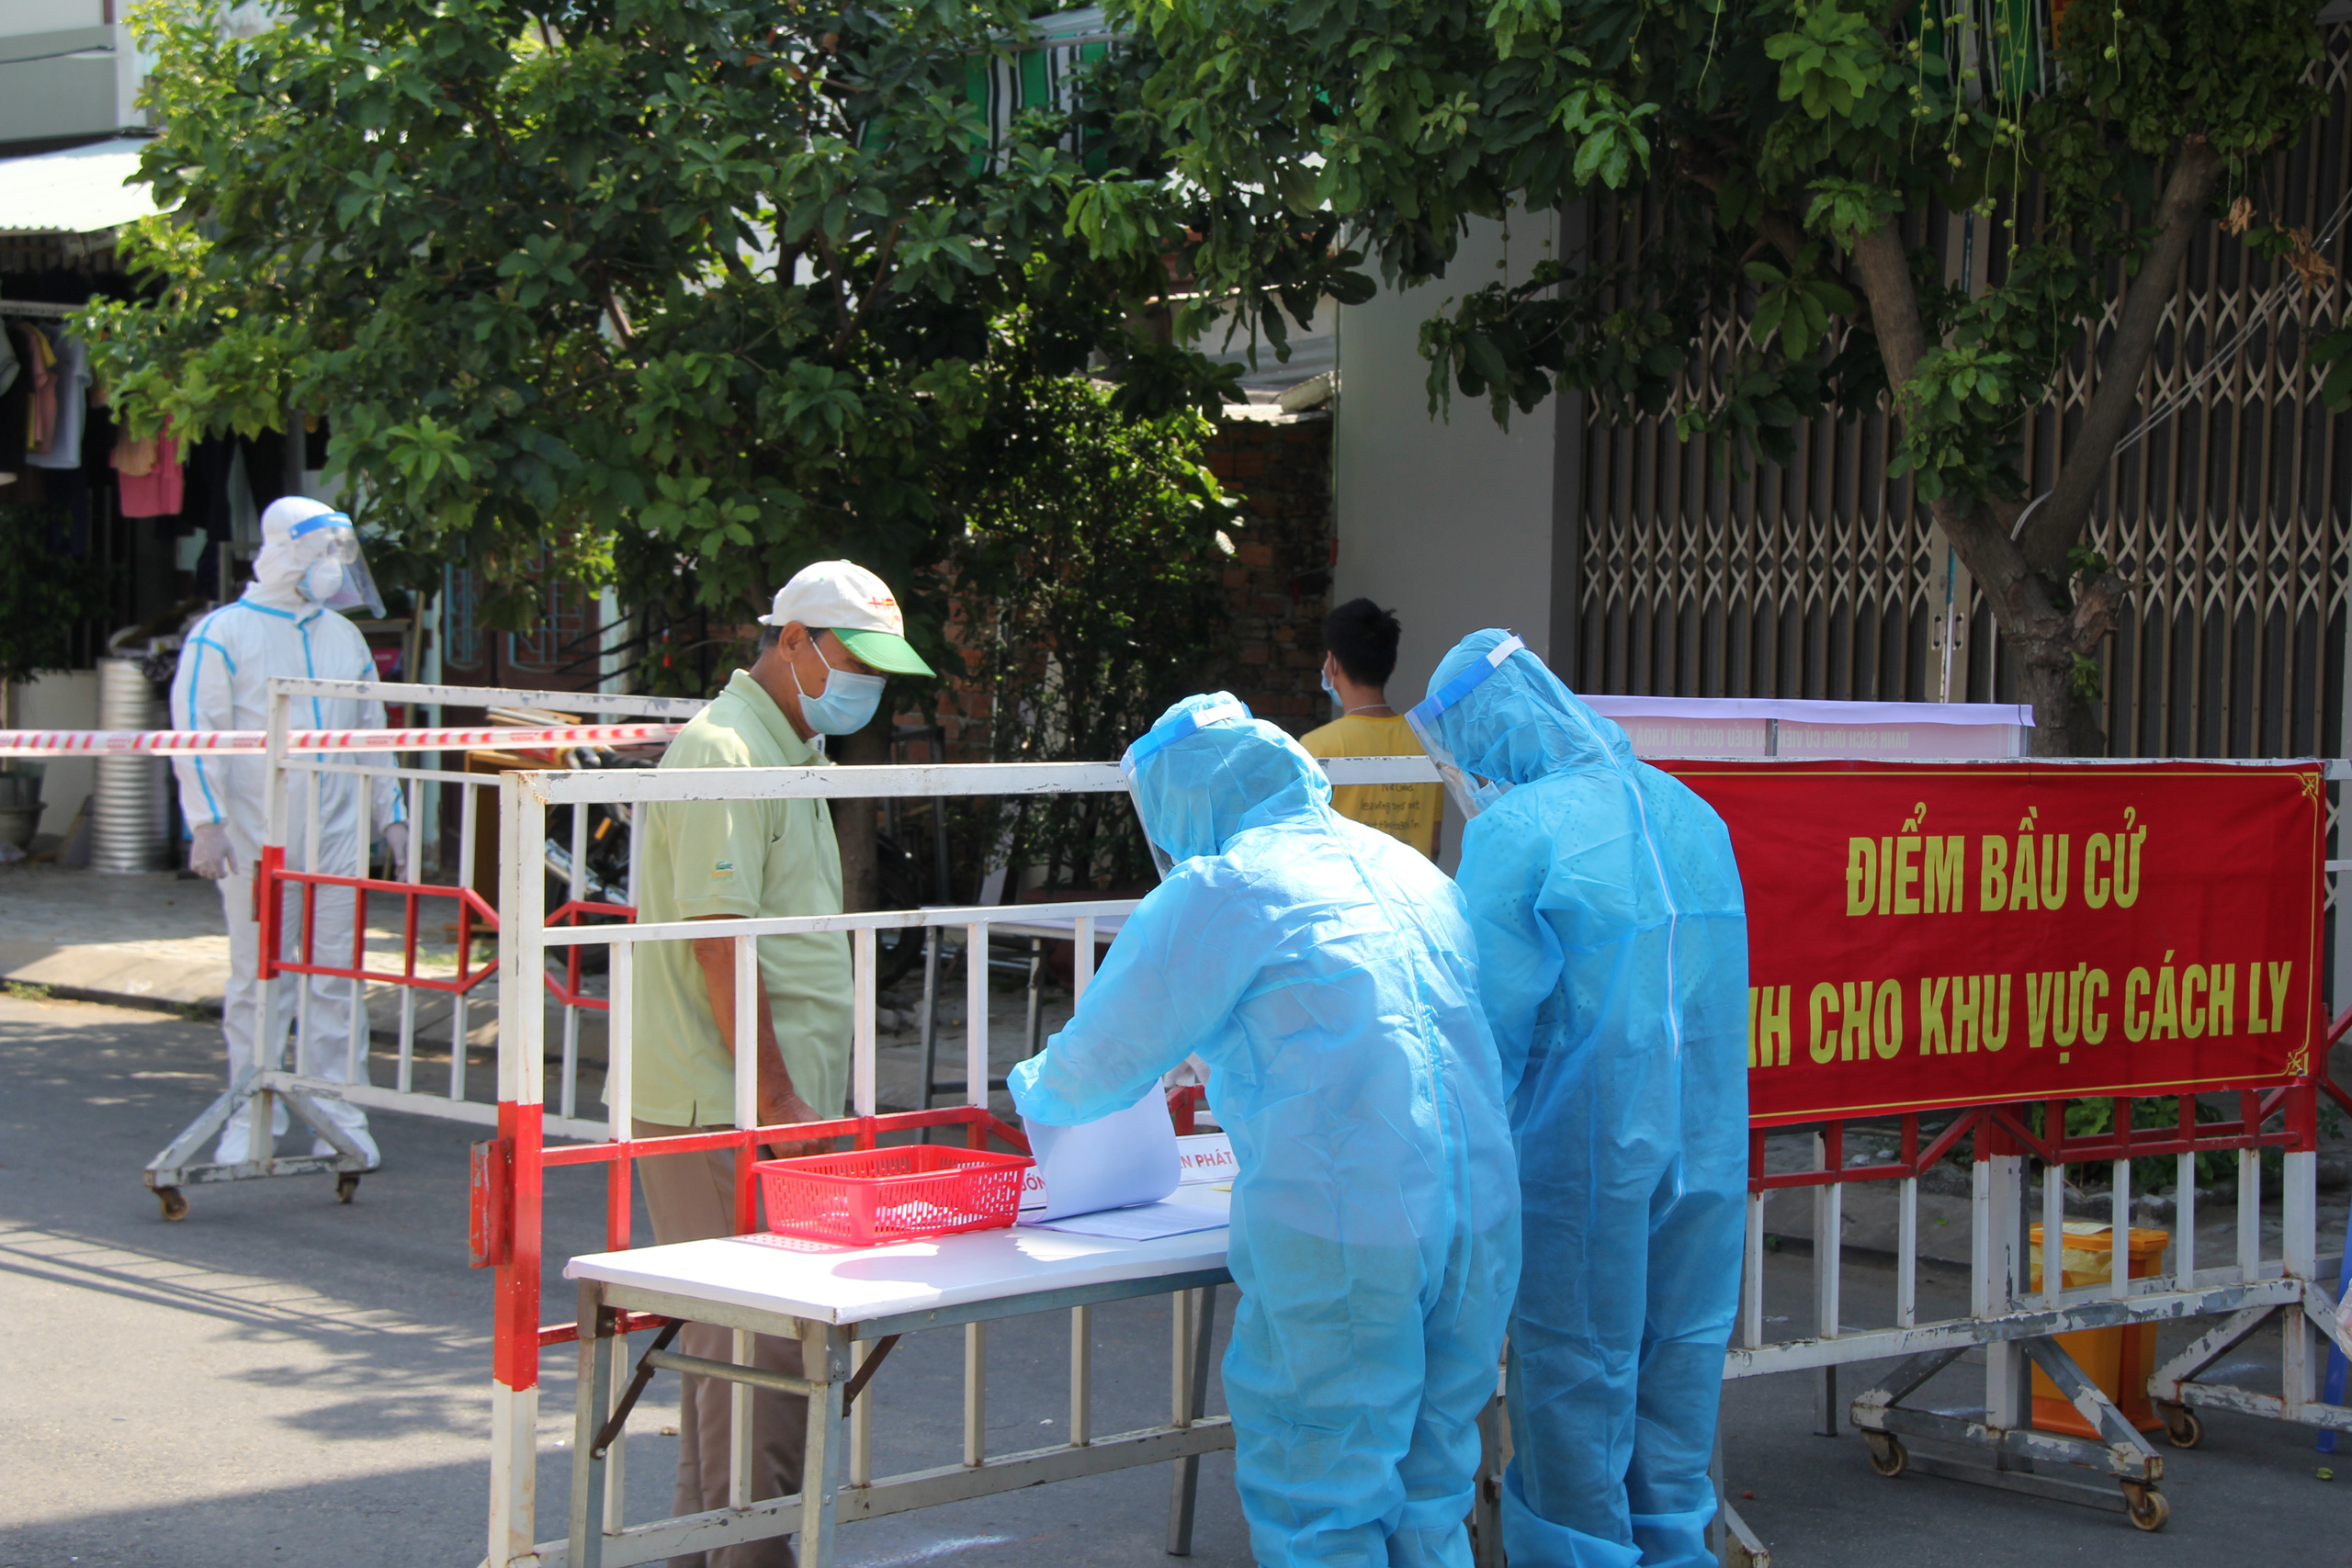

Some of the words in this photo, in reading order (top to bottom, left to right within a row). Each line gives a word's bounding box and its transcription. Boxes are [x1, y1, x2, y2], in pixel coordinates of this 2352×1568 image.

[1846, 801, 1964, 916] ĐIỂM
[1980, 806, 2069, 912] BẦU
[2084, 806, 2147, 908] CỬ
[1809, 979, 1903, 1065] CHO
[1919, 974, 2012, 1056] KHU
[2026, 961, 2110, 1065] VỰC
[2123, 950, 2236, 1043] CÁCH
[2247, 960, 2293, 1034] LY
[1180, 1155, 1193, 1168] N
[1194, 1148, 1233, 1168] PHÁT
